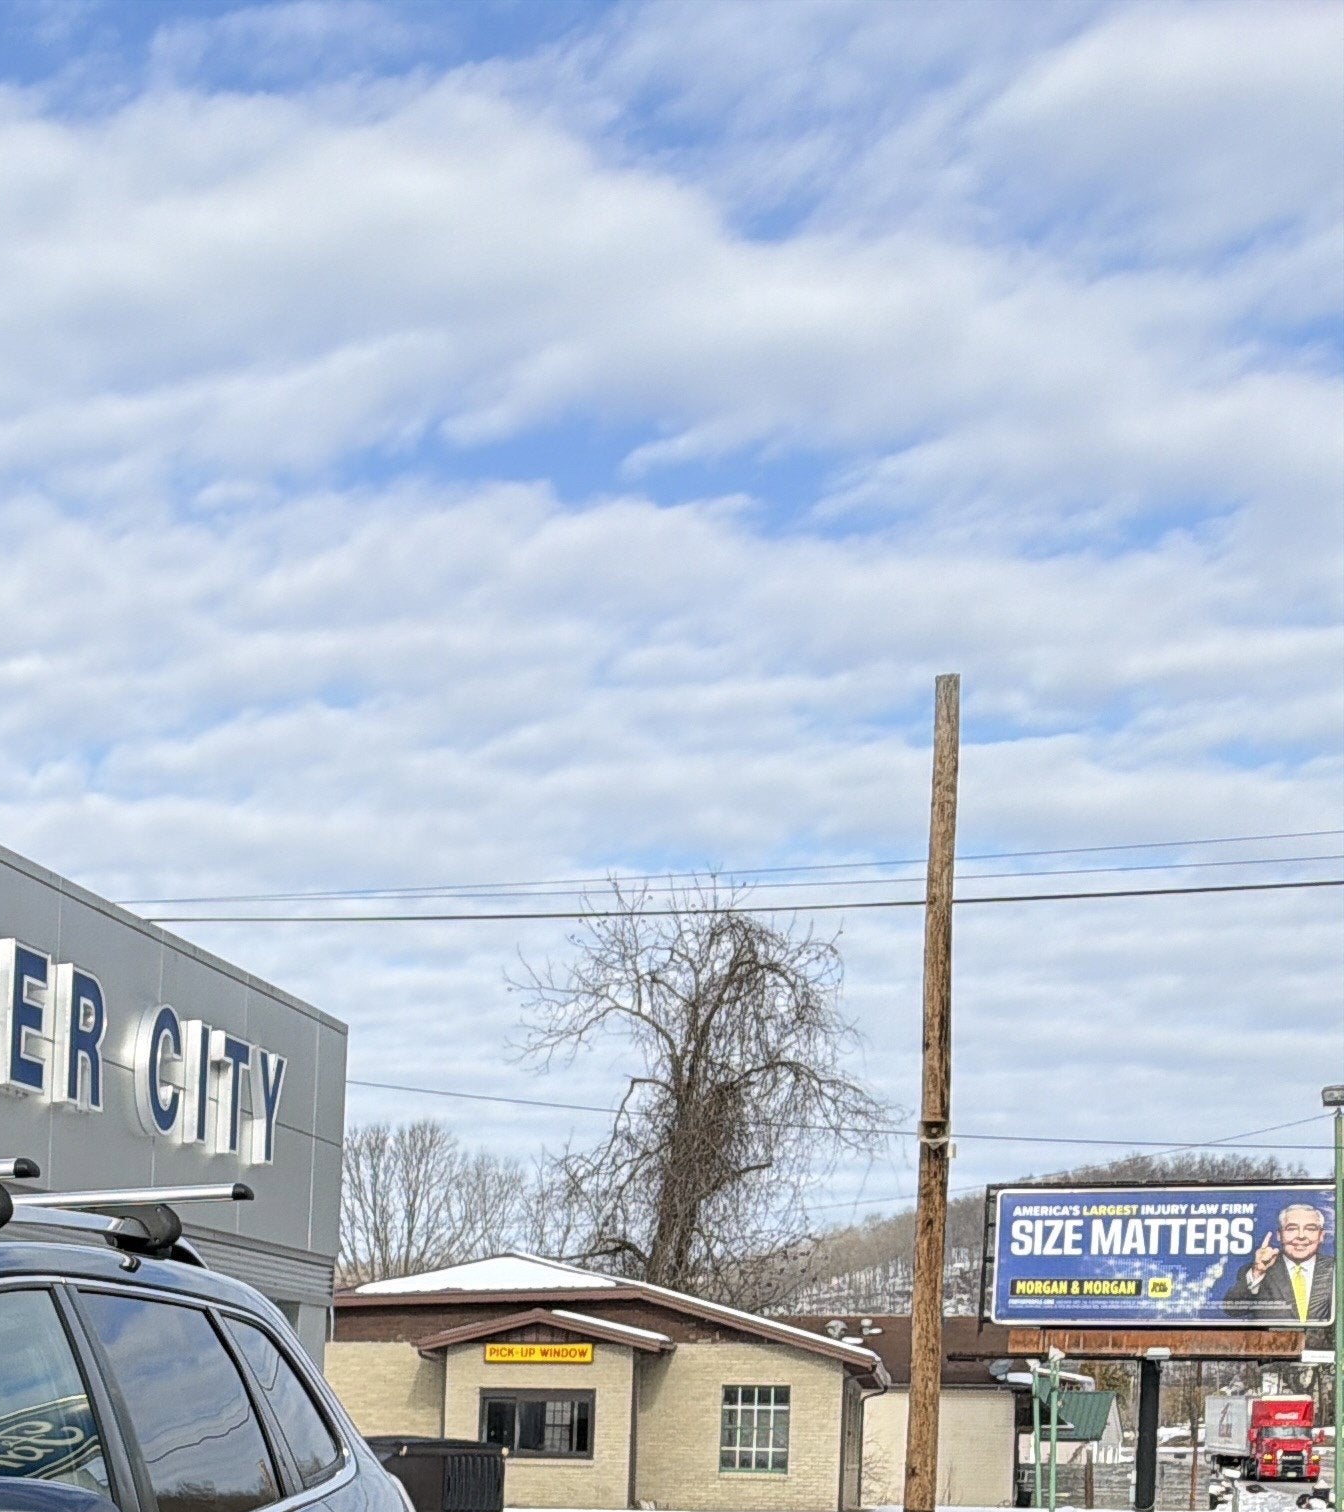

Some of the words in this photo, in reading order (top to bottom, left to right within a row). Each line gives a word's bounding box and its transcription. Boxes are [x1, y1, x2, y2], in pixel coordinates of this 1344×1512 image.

[135, 1003, 288, 1165] CITY
[1012, 1205, 1081, 1217] AMERICA'S
[1082, 1204, 1139, 1216] LARGEST
[1140, 1204, 1189, 1216] INJURY
[1190, 1203, 1220, 1215] LAW
[1220, 1203, 1255, 1215] FIRM
[1010, 1219, 1084, 1255] SIZE
[1090, 1217, 1255, 1255] MATTERS
[1015, 1280, 1068, 1295] MORGAN
[1070, 1280, 1080, 1295] &
[1082, 1280, 1136, 1295] MORGAN
[539, 1347, 589, 1358] WINDOW
